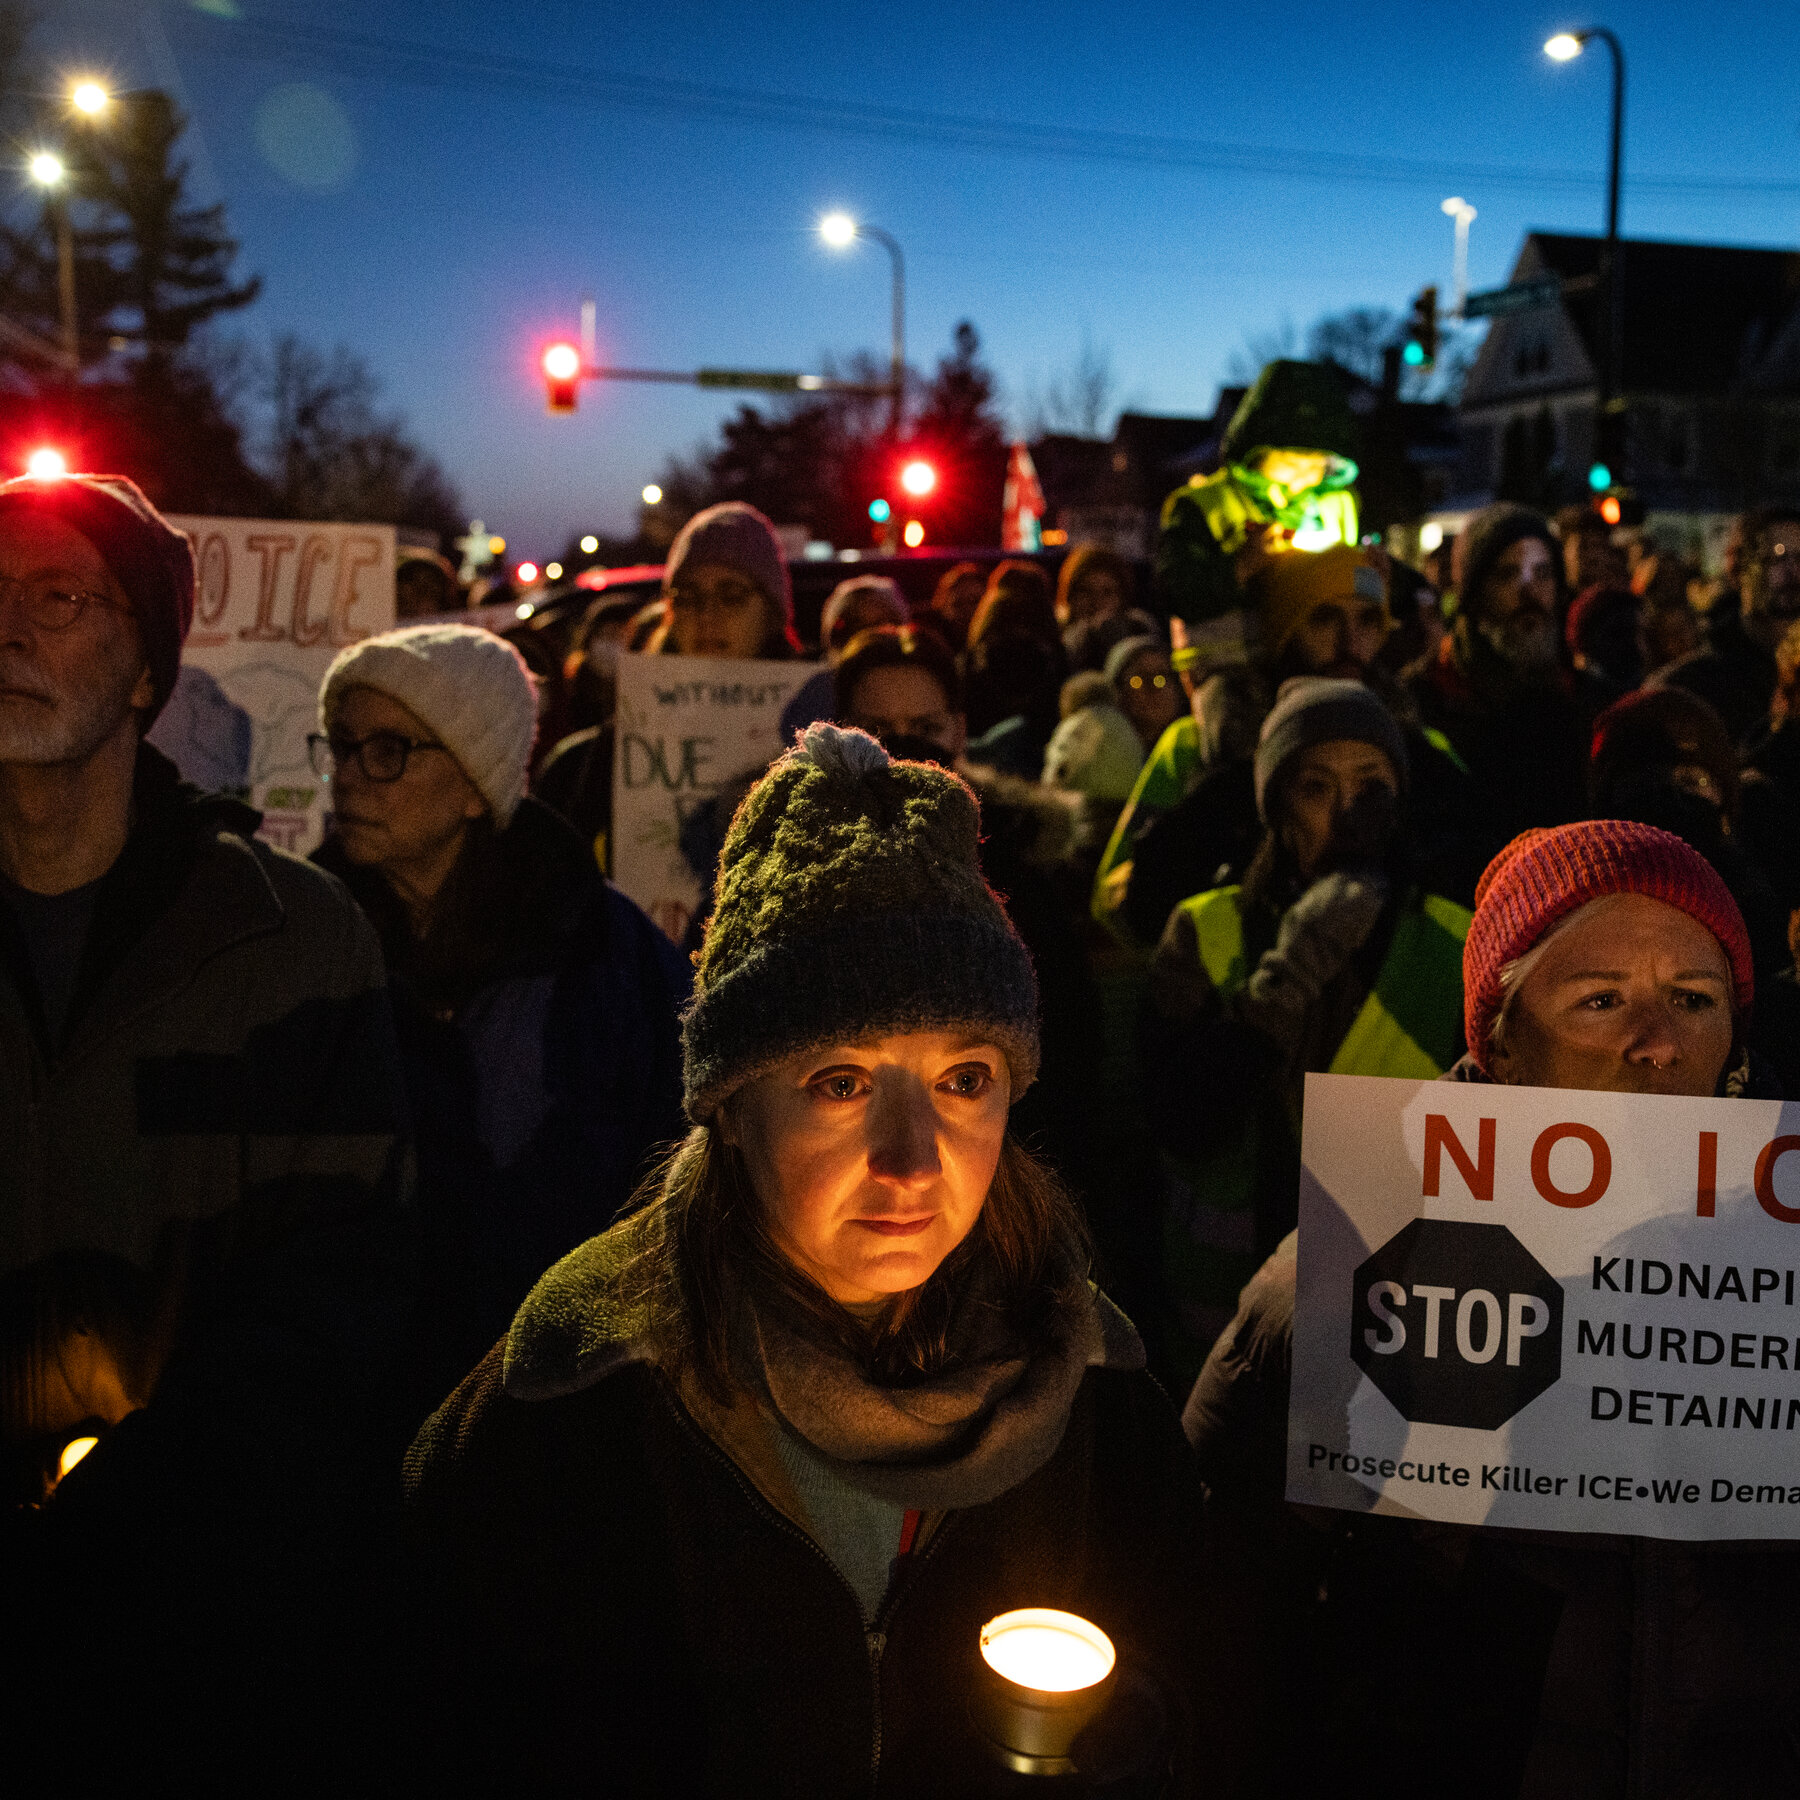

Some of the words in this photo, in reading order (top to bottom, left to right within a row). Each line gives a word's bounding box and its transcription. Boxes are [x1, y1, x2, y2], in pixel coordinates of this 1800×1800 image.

[189, 531, 231, 628] O
[239, 532, 385, 648] ICE
[622, 734, 716, 791] DUE
[1422, 1114, 1612, 1209] NO
[1593, 1257, 1795, 1306] KIDNAPI
[1364, 1281, 1550, 1366] STOP
[1308, 1444, 1470, 1487] Prosecute
[1481, 1465, 1568, 1496] Killer
[1711, 1479, 1800, 1504] Dema
